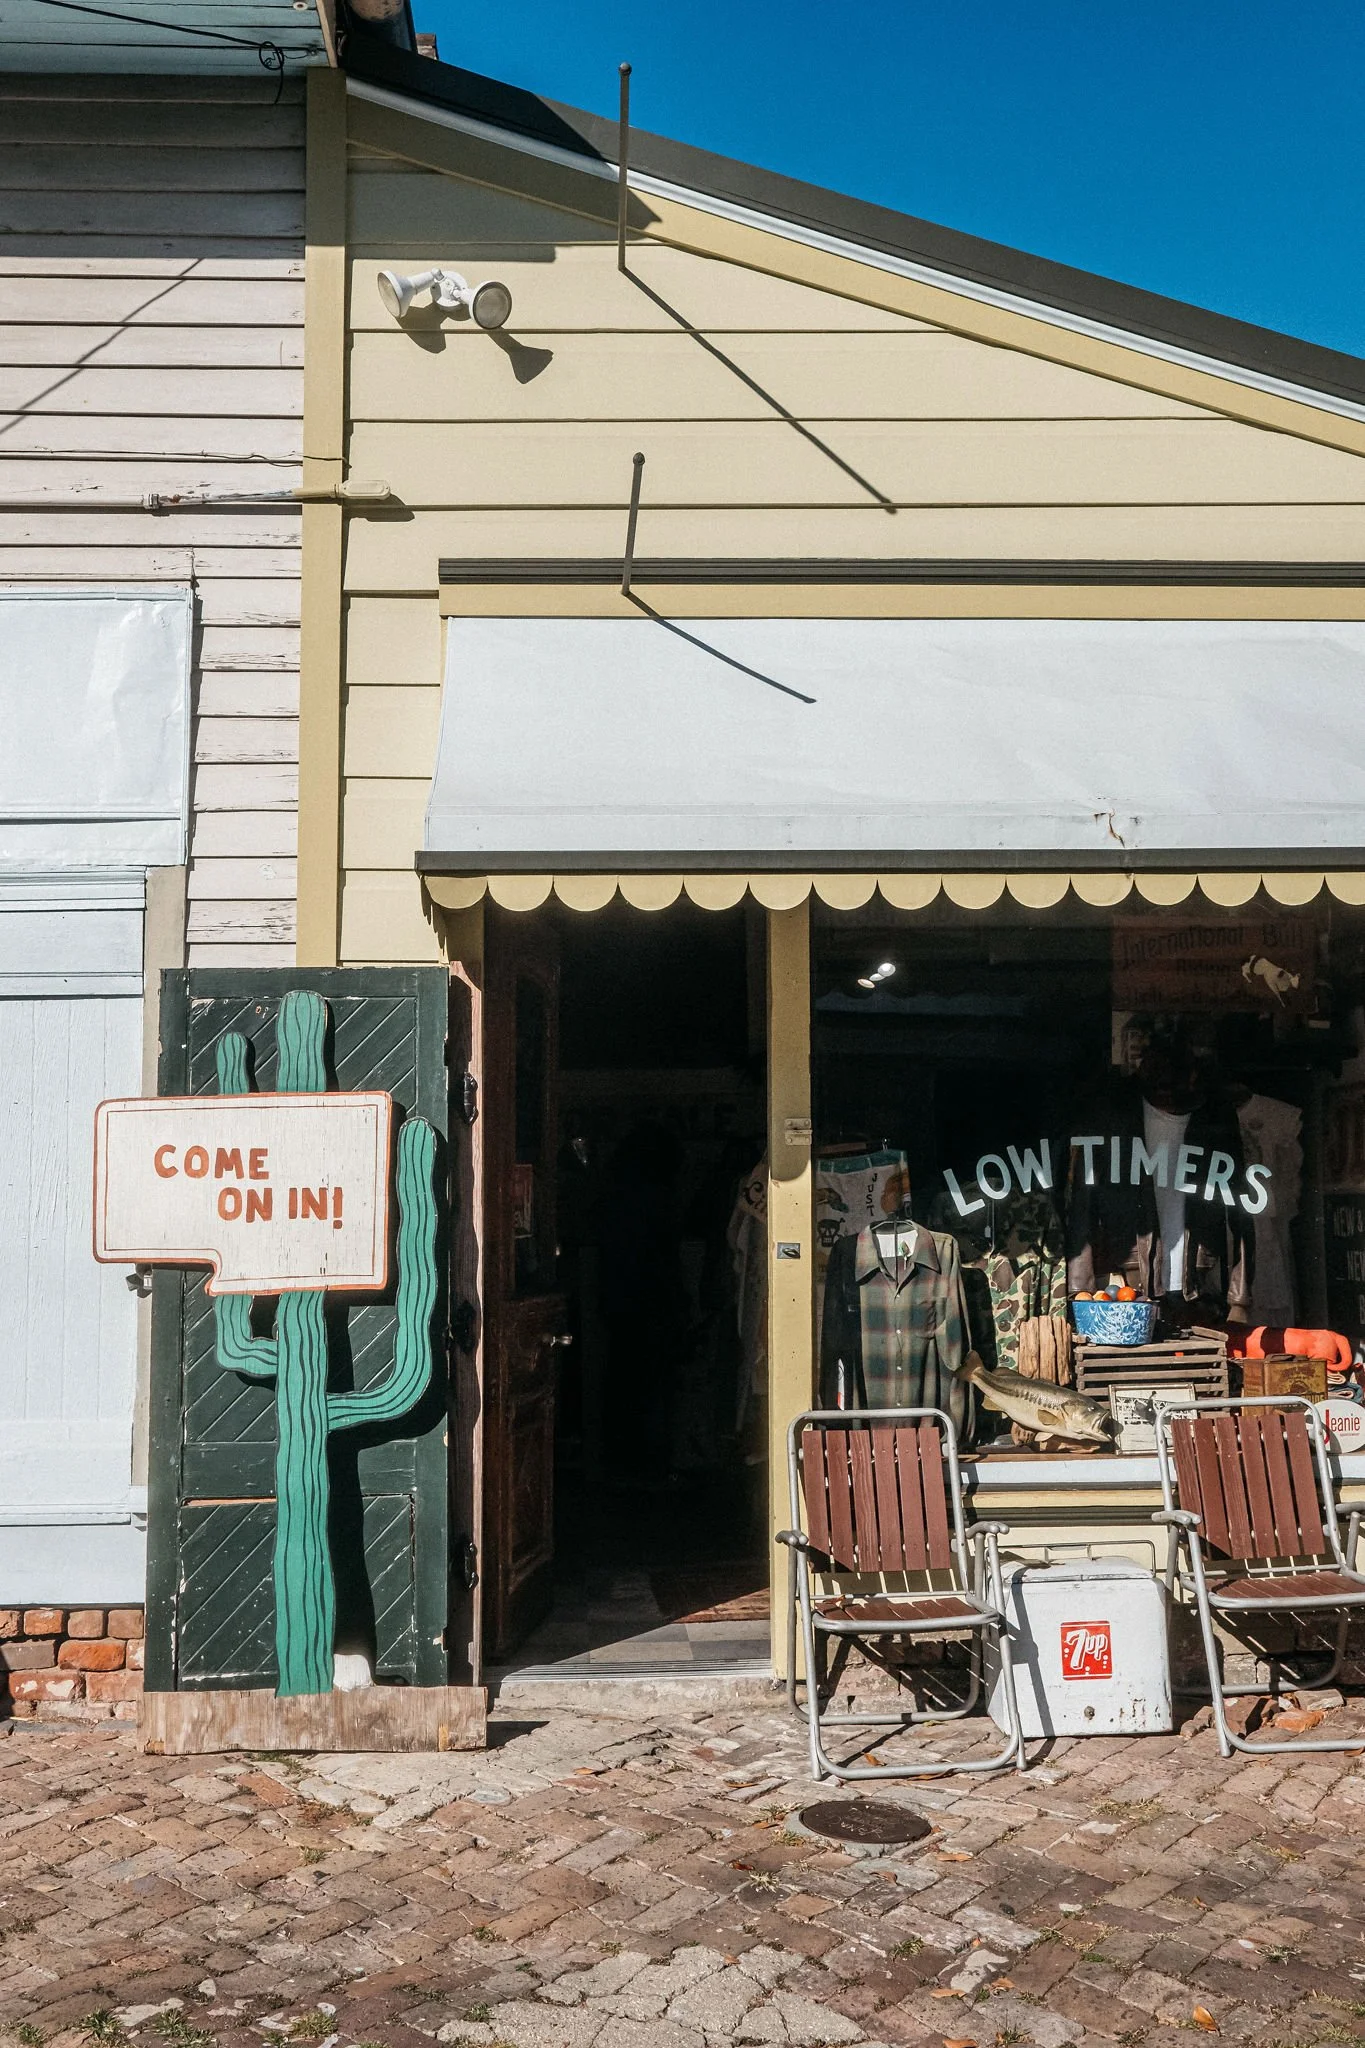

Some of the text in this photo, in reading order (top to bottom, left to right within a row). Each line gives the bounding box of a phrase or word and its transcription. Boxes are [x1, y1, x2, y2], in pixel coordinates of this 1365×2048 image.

[154, 1144, 269, 1180] COME
[943, 1136, 1272, 1217] LOW TIMERS
[217, 1186, 343, 1229] ON IN!
[865, 1172, 878, 1217] JUST
[1323, 1409, 1361, 1446] Jeanie
